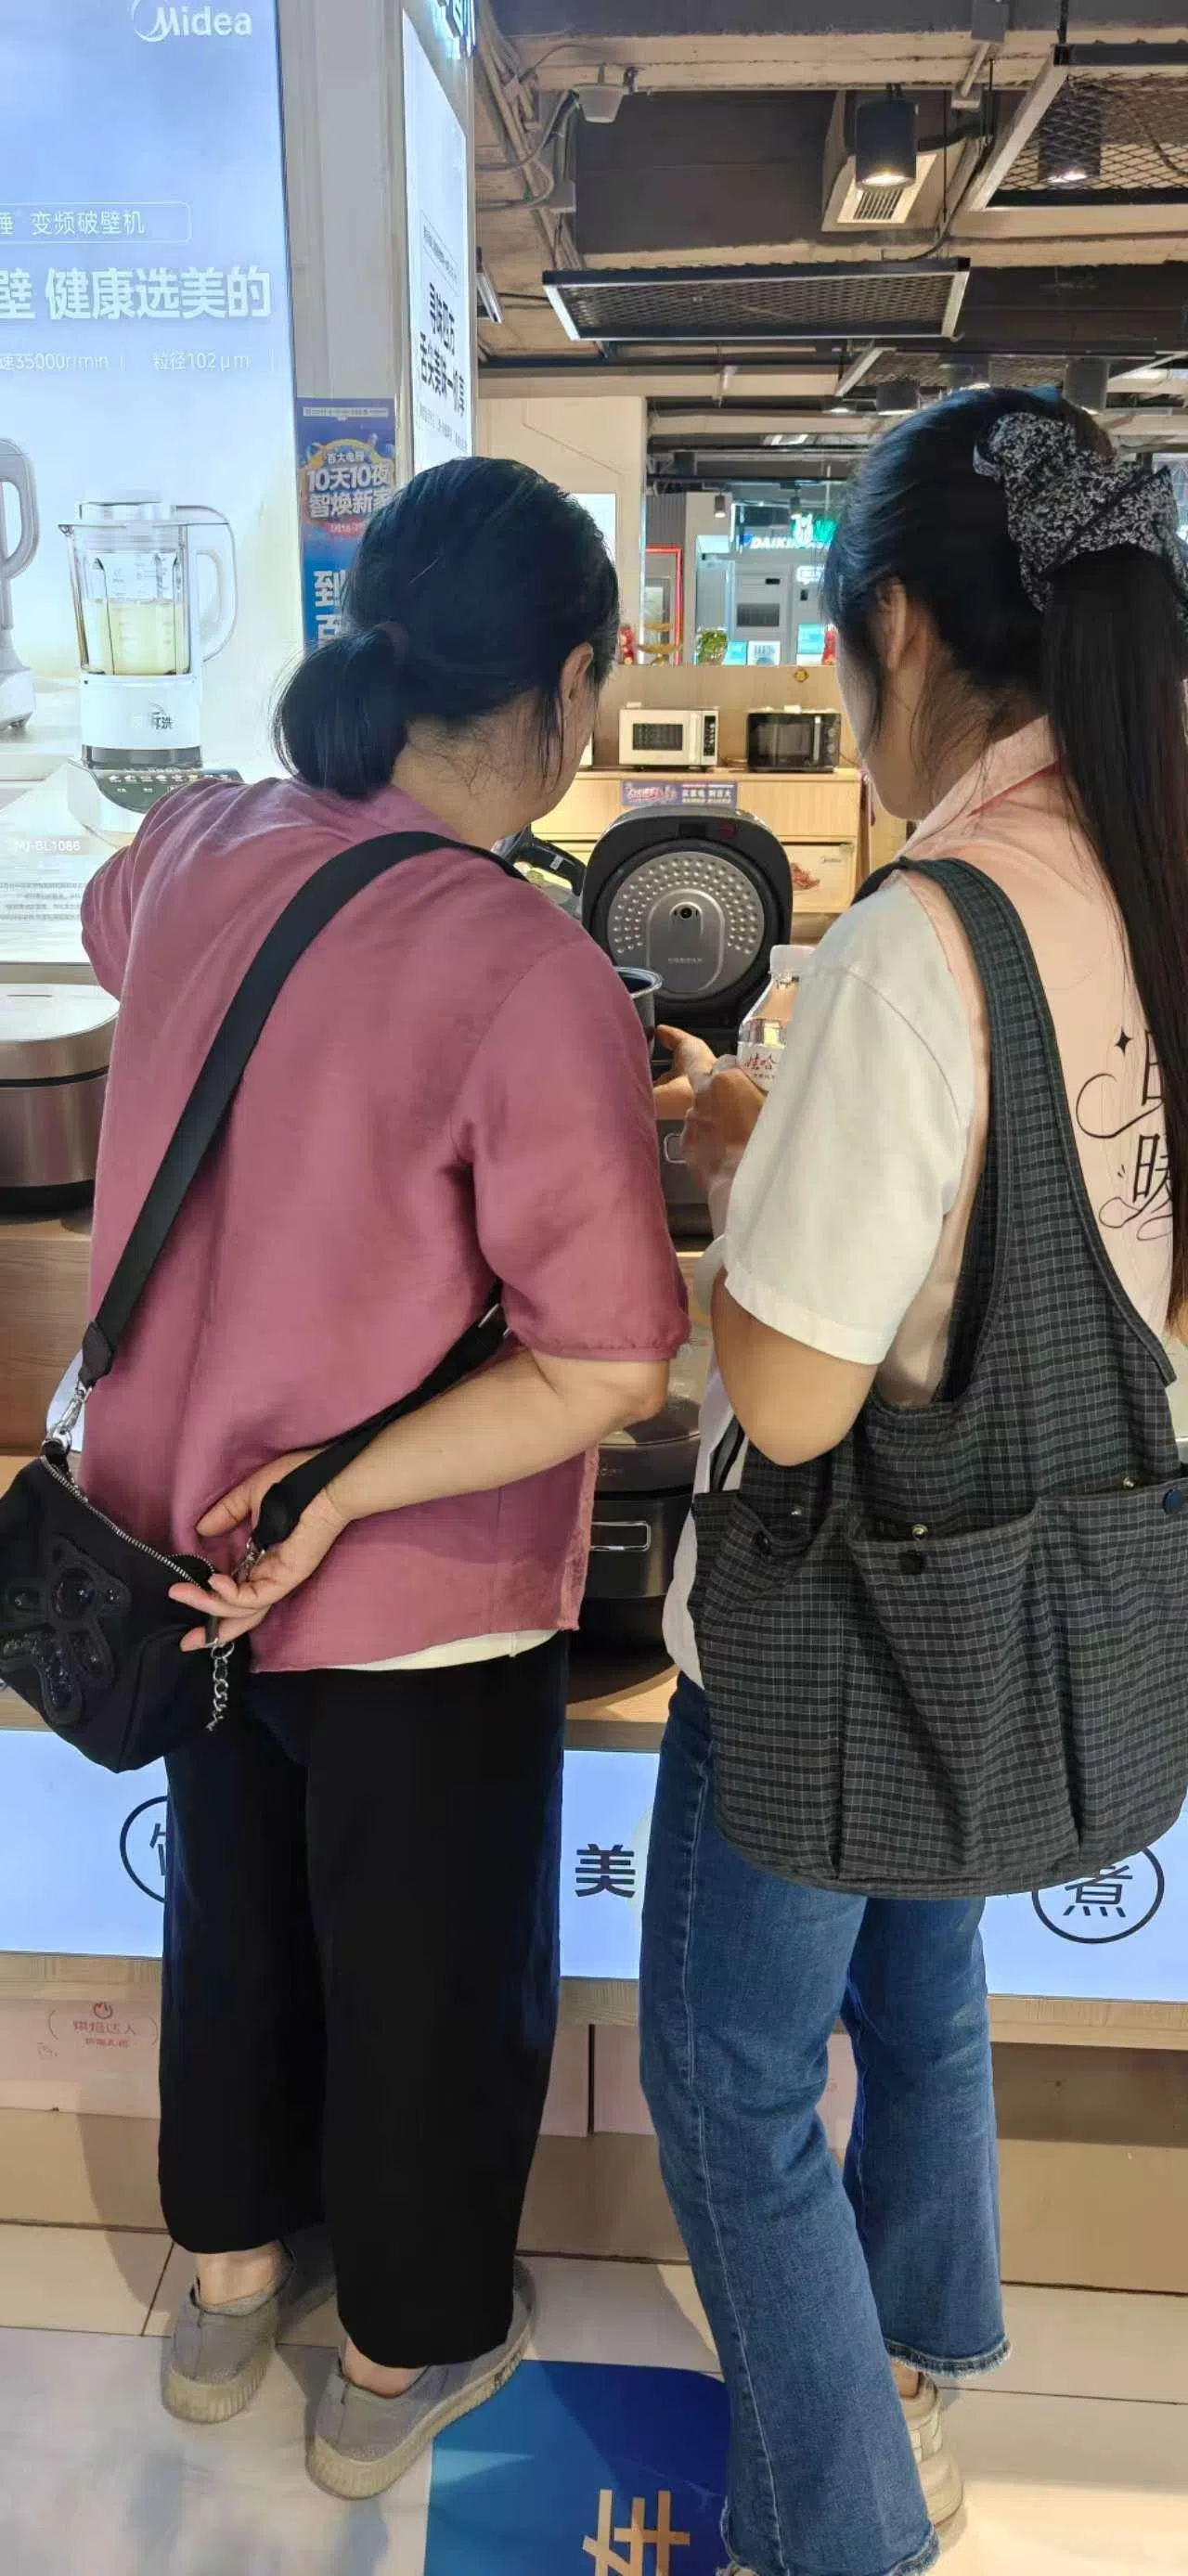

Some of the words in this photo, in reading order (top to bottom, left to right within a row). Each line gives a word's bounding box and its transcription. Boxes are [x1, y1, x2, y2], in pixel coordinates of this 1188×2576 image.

[152, 6, 252, 38] Midea
[32, 212, 145, 236] 变频破壁机
[45, 264, 272, 321] 健康选美的
[307, 464, 391, 491] 10天10夜
[575, 1844, 636, 1899] 美
[1063, 1865, 1133, 1918] 煮
